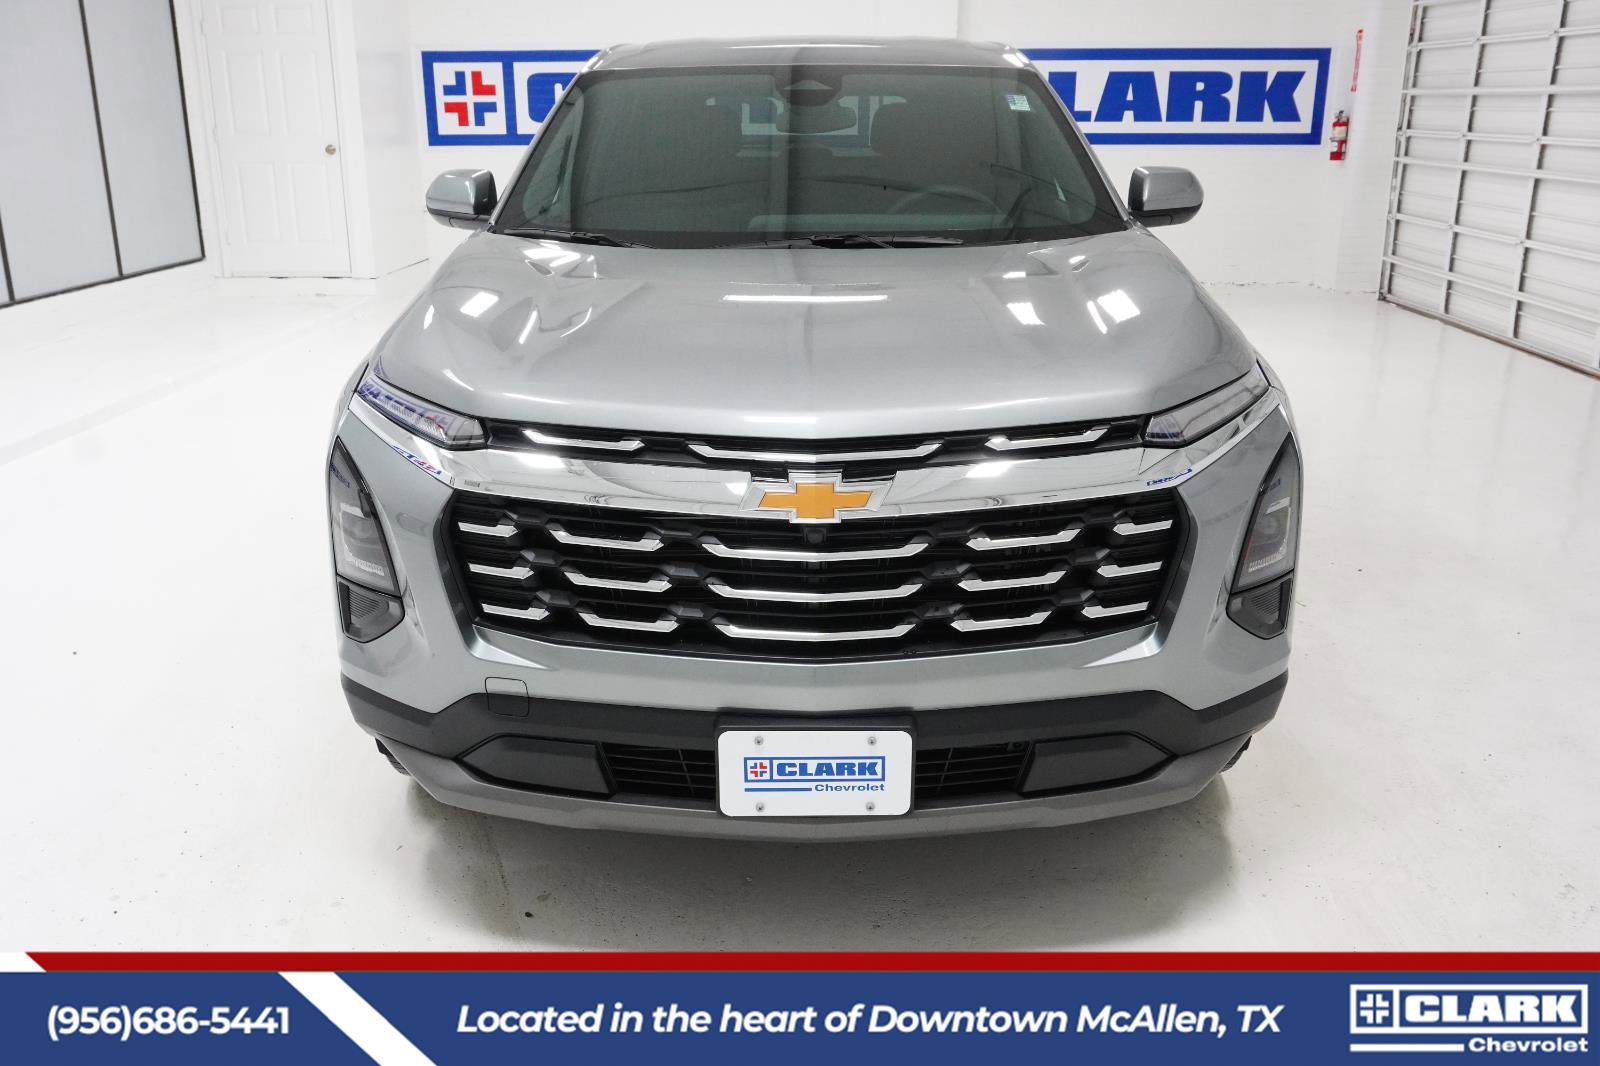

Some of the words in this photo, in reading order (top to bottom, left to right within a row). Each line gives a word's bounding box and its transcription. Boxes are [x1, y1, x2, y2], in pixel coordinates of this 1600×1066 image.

[1048, 71, 1305, 123] LARK
[776, 762, 878, 777] CLARK
[814, 783, 885, 792] Chevrolet
